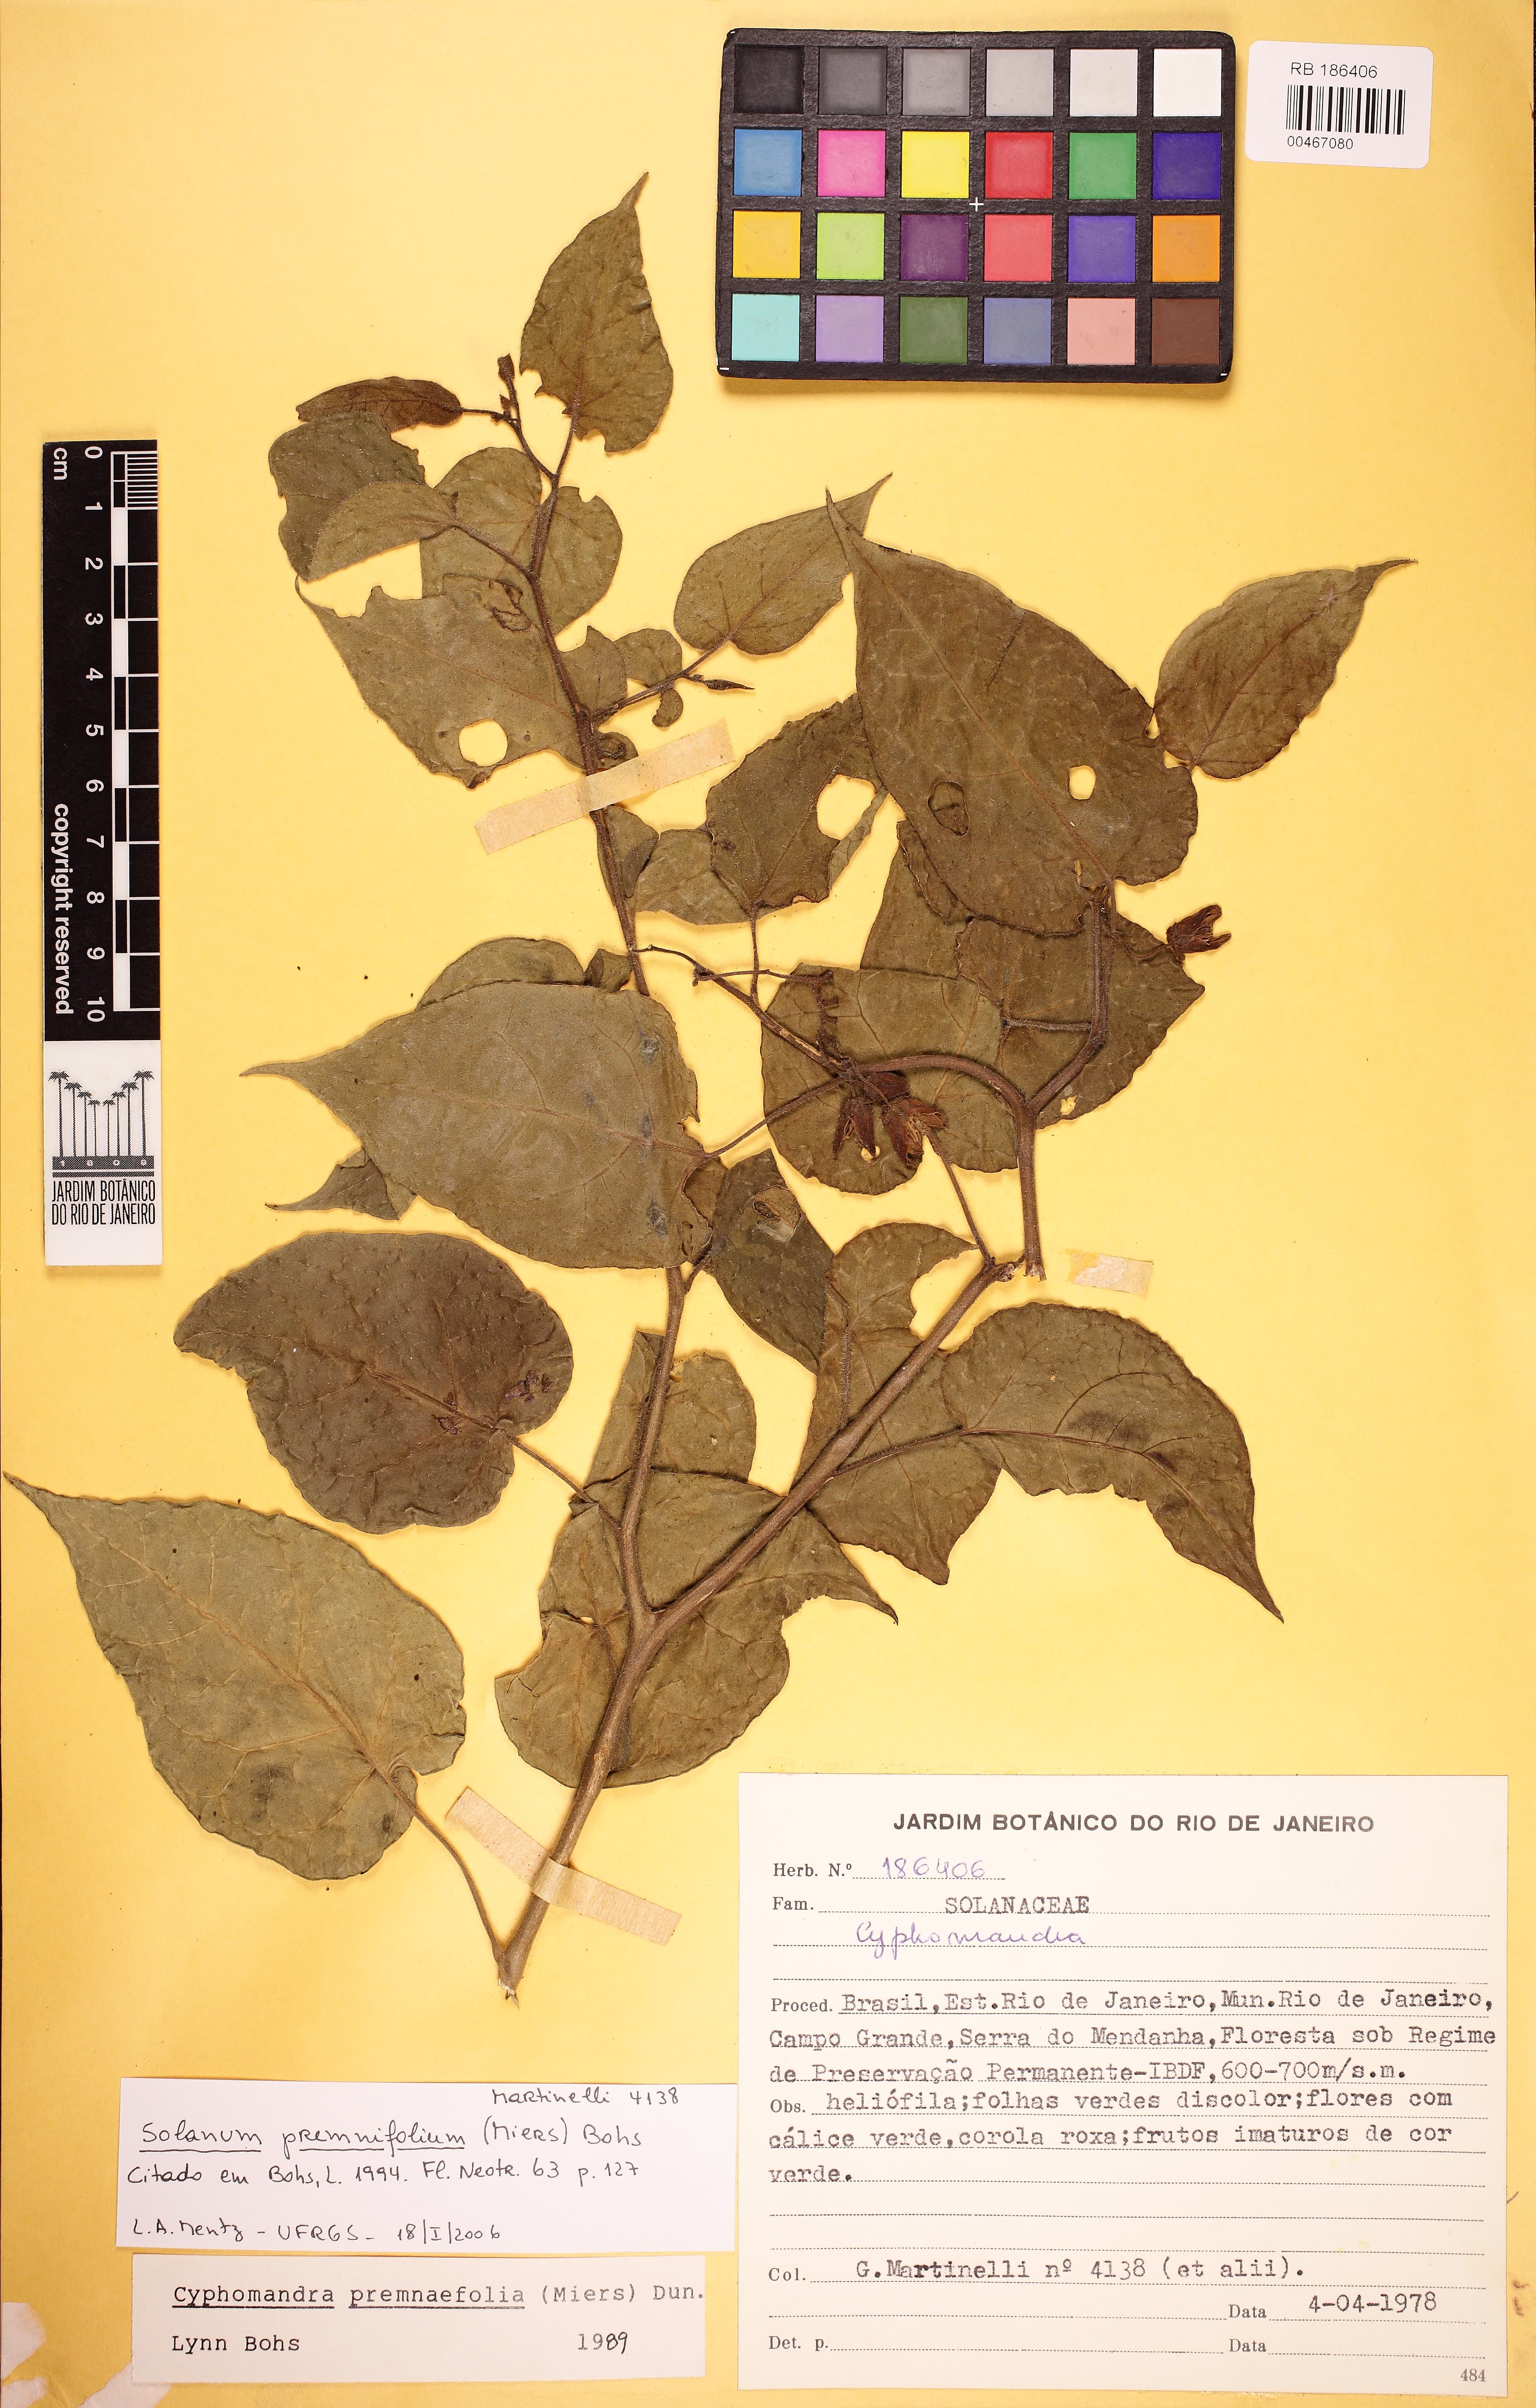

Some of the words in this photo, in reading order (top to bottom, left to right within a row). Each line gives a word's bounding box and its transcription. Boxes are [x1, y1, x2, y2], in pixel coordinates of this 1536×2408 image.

[1291, 62, 1314, 75] RB
[1321, 64, 1378, 78] 186406
[1287, 135, 1353, 149] 00467080
[85, 446, 103, 458] 0
[53, 447, 67, 480] cm
[85, 502, 103, 510] 1
[85, 557, 103, 569] 2
[85, 613, 103, 625] 3
[86, 668, 103, 680] 4
[86, 724, 104, 736] 5
[86, 780, 104, 792] 6
[86, 835, 104, 848] 7
[51, 803, 73, 911] copyright
[87, 891, 105, 904] 8
[87, 947, 105, 960] 9
[55, 917, 74, 1014] reserved
[87, 997, 105, 1022] 10
[52, 1180, 95, 1202] JARDIM
[100, 1179, 155, 1201] BOTÂNICO
[52, 1204, 67, 1225] DO
[71, 1204, 88, 1225] RIO
[93, 1204, 106, 1225] DE
[110, 1203, 155, 1225] JANEIRO
[894, 1814, 981, 1831] JARDIM
[993, 1811, 1117, 1831] BOTÂNICO
[1131, 1815, 1163, 1831] DO
[1177, 1815, 1216, 1831] RIO
[1228, 1815, 1260, 1831] DE
[1273, 1816, 1374, 1832] JANEIRO
[773, 1863, 818, 1877] Herb.
[882, 1857, 985, 1879] 186406
[772, 1897, 814, 1910] Fam.
[945, 1896, 1090, 1914] SOLANACEAE
[771, 1998, 833, 2012] Proced.
[1061, 1992, 1088, 2009] de
[1338, 1990, 1365, 2008] de
[1381, 1989, 1493, 2011] Janeiro,
[769, 2030, 841, 2051] Campo
[1047, 2028, 1073, 2045] do
[1352, 2026, 1393, 2044] sob
[1409, 2027, 1496, 2046] Regime
[770, 2066, 797, 2083] de
[811, 2059, 972, 2084] Preservação
[492, 2087, 610, 2104] Martinelli
[630, 2087, 679, 2105] 4138
[770, 2099, 806, 2113] Obs.
[1075, 2091, 1160, 2109] verdes
[1409, 2091, 1452, 2106] com
[142, 2120, 262, 2145] Solanum
[282, 2119, 465, 2160] premnifolium
[484, 2115, 567, 2145] (Miers)
[583, 2124, 641, 2146] Bohs
[769, 2126, 855, 2149] cálice
[1235, 2125, 1349, 2143] imaturos
[1366, 2124, 1392, 2142] de
[1409, 2126, 1452, 2142] cor
[128, 2163, 202, 2183] Citado
[220, 2170, 248, 2184] em
[355, 2165, 407, 2182] 1994.
[423, 2161, 450, 2179] Fl.
[533, 2158, 559, 2178] 63
[578, 2168, 595, 2187] p.
[604, 2162, 639, 2176] 127
[769, 2165, 852, 2182] verde.
[768, 2268, 806, 2282] Col.
[856, 2259, 1029, 2279] G.Martinelli
[1045, 2258, 1073, 2278] nº
[1090, 2257, 1146, 2278] 4138
[1163, 2255, 1205, 2279] (et
[1220, 2255, 1303, 2279] alii).
[174, 2286, 334, 2306] Cyphomandra
[350, 2286, 524, 2306] premnaefolia
[542, 2284, 636, 2304] (Miers)
[653, 2285, 704, 2300] Dun.
[1228, 2305, 1267, 2319] Data
[1308, 2291, 1438, 2313] 4-04-1978
[172, 2335, 227, 2354] Lynn
[245, 2335, 300, 2351] Bohs
[578, 2331, 628, 2354] 1989
[769, 2336, 801, 2349] Det.
[815, 2338, 829, 2352] p.
[1229, 2339, 1267, 2353] Data
[1461, 2369, 1486, 2382] 484
